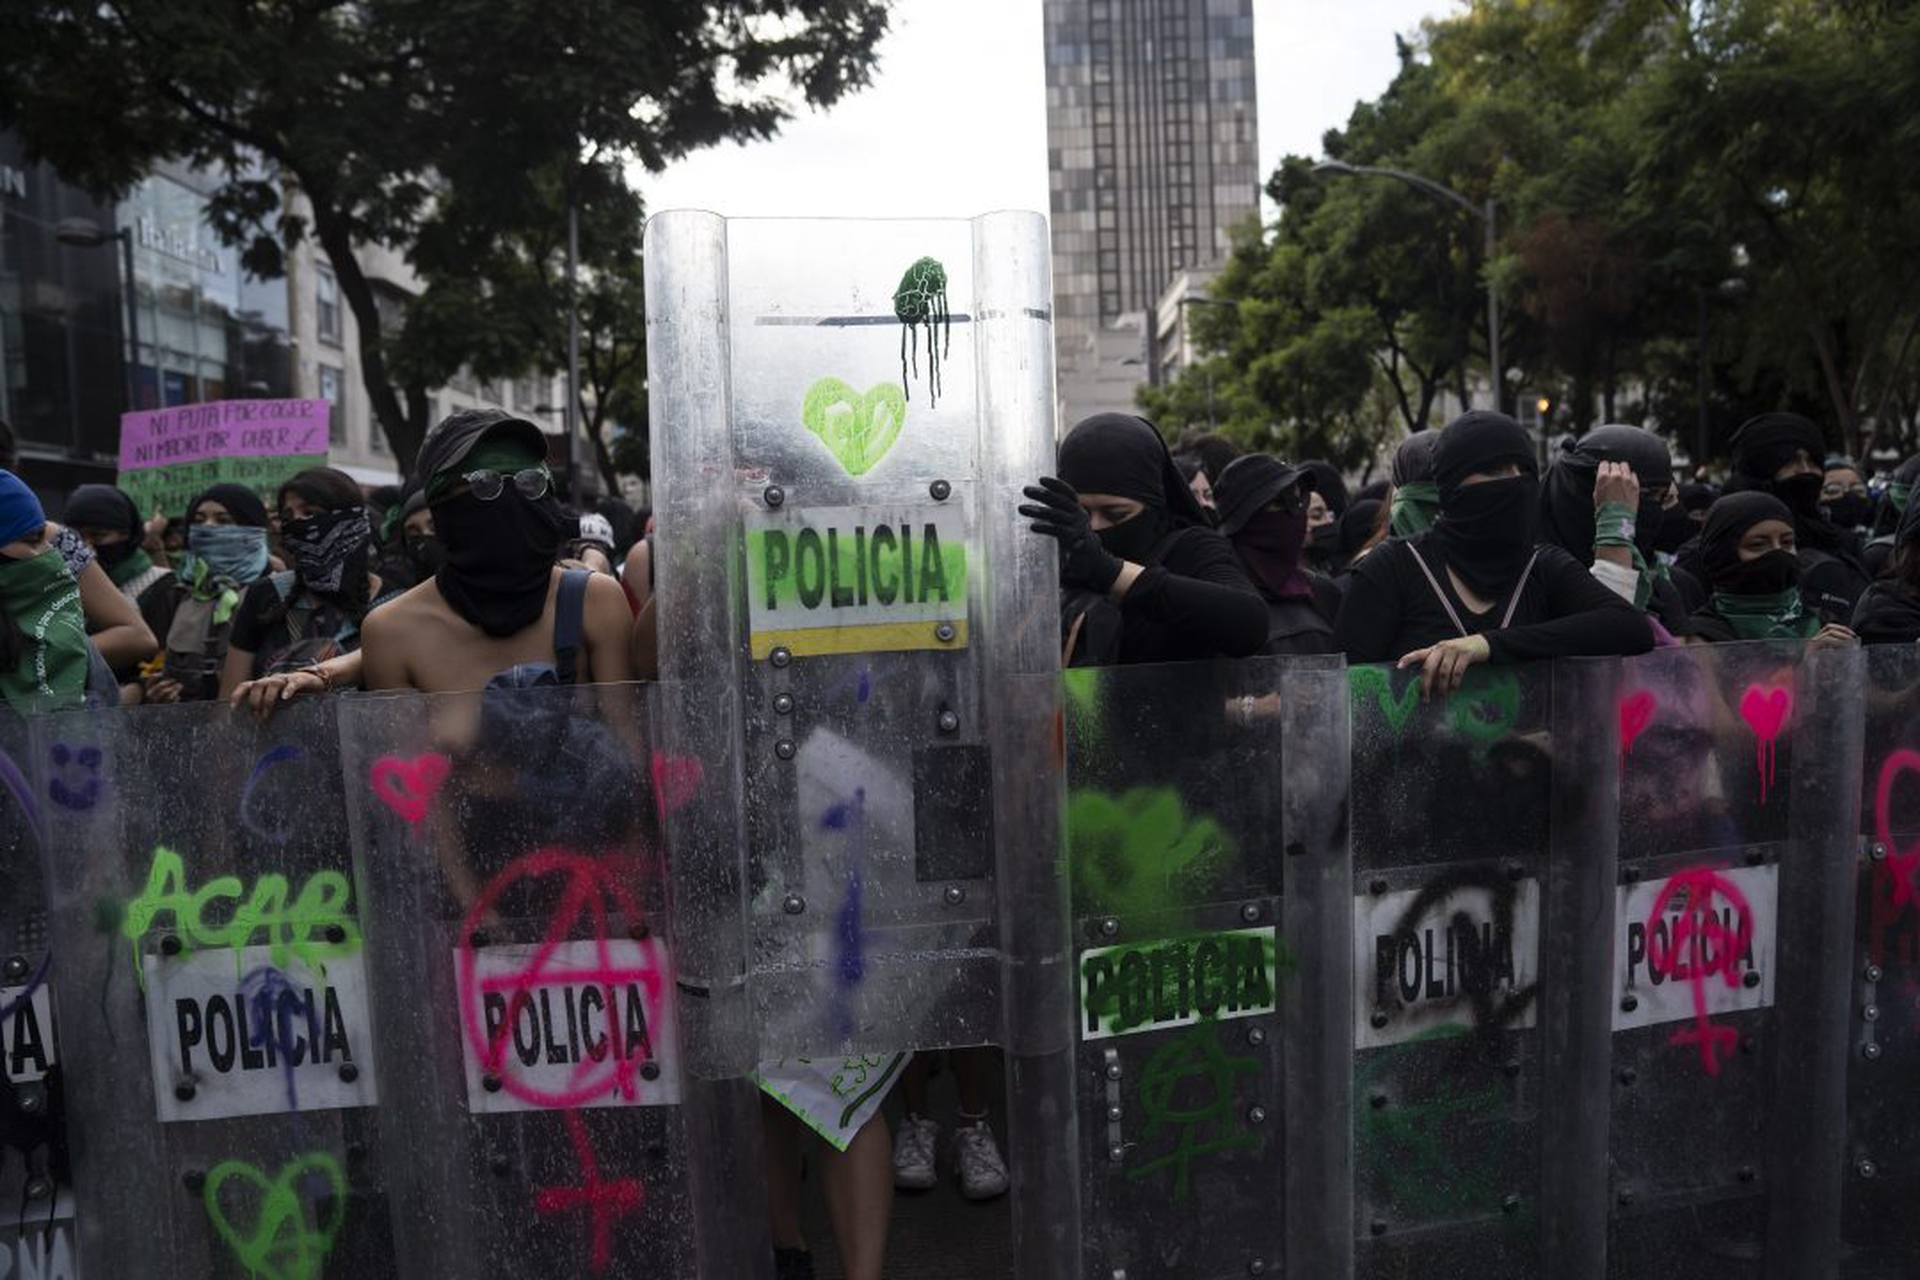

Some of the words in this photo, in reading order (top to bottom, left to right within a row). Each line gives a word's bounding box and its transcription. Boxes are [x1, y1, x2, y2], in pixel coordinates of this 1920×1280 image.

[764, 523, 949, 610] POLICIA
[124, 846, 363, 967] ACAB
[1628, 907, 1754, 990] POLICIA
[484, 983, 653, 1070] POLICIA
[1086, 937, 1271, 1032] POLICIA
[176, 986, 352, 1074] POLICIA
